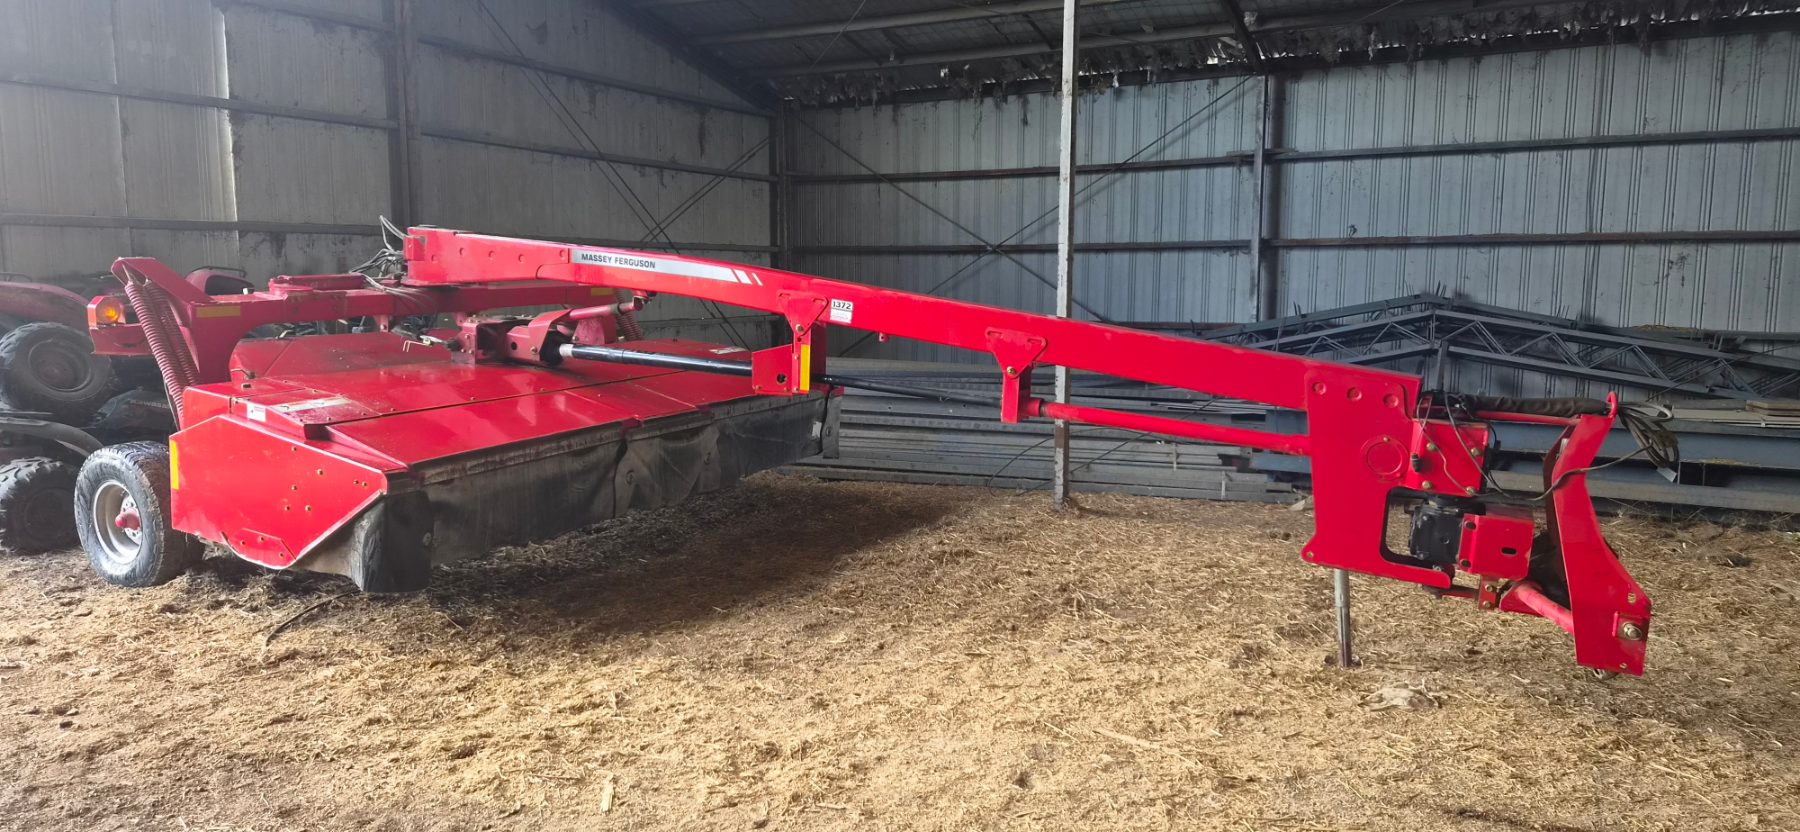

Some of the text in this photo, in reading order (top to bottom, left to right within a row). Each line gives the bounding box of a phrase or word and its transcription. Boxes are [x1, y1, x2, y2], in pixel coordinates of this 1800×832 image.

[581, 253, 656, 269] MASSEY FERGUSON
[833, 301, 851, 309] 1372
